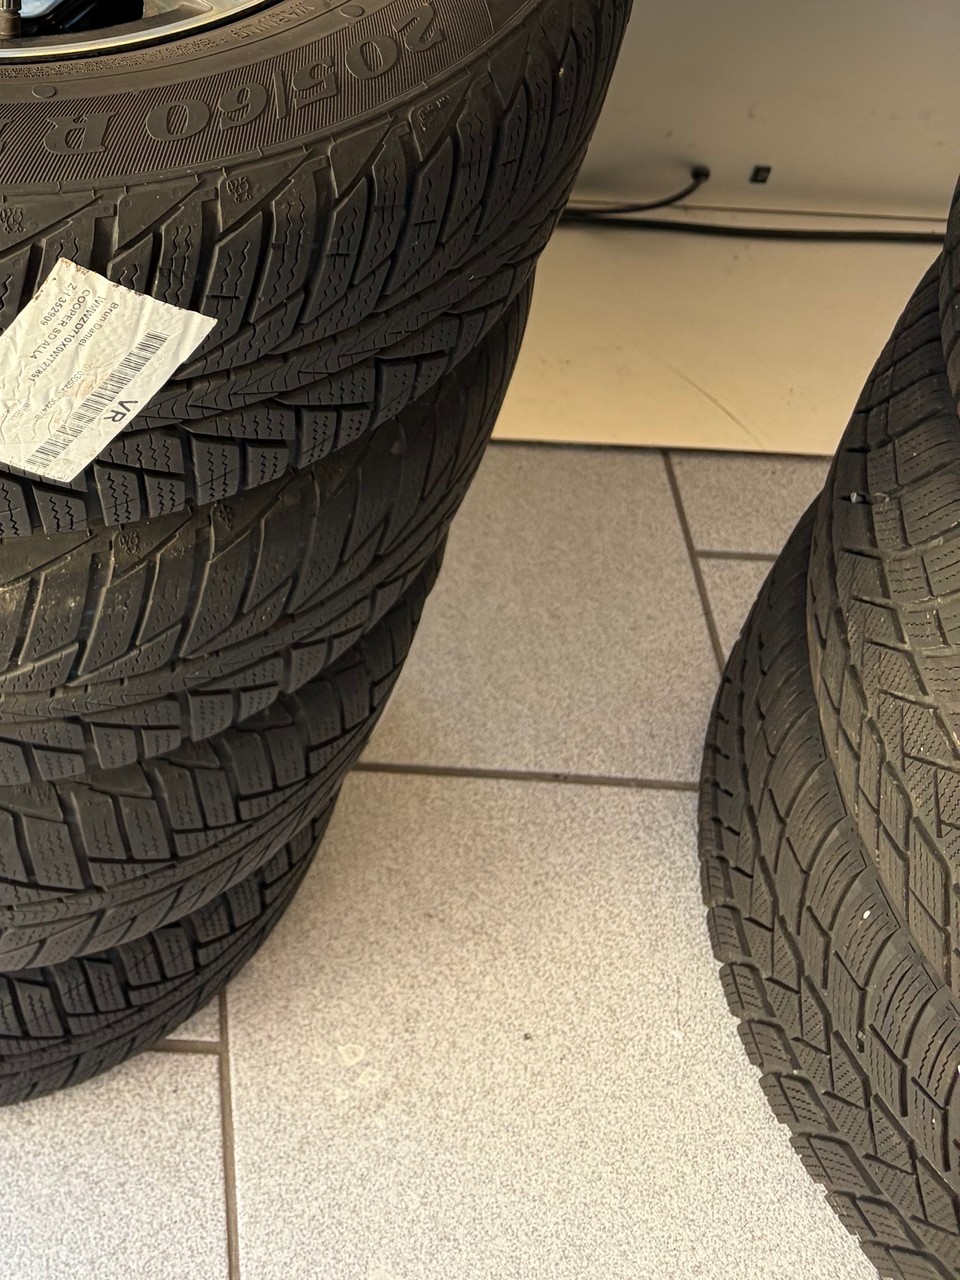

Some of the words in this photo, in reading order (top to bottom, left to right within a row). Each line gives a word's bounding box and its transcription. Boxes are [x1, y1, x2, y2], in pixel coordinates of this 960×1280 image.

[146, 1, 445, 142] 205/60
[44, 112, 117, 156] R
[41, 296, 67, 326] 352909
[59, 289, 91, 327] COOPER
[48, 327, 62, 340] SD
[30, 340, 51, 360] ALL4
[103, 399, 139, 424] VR
